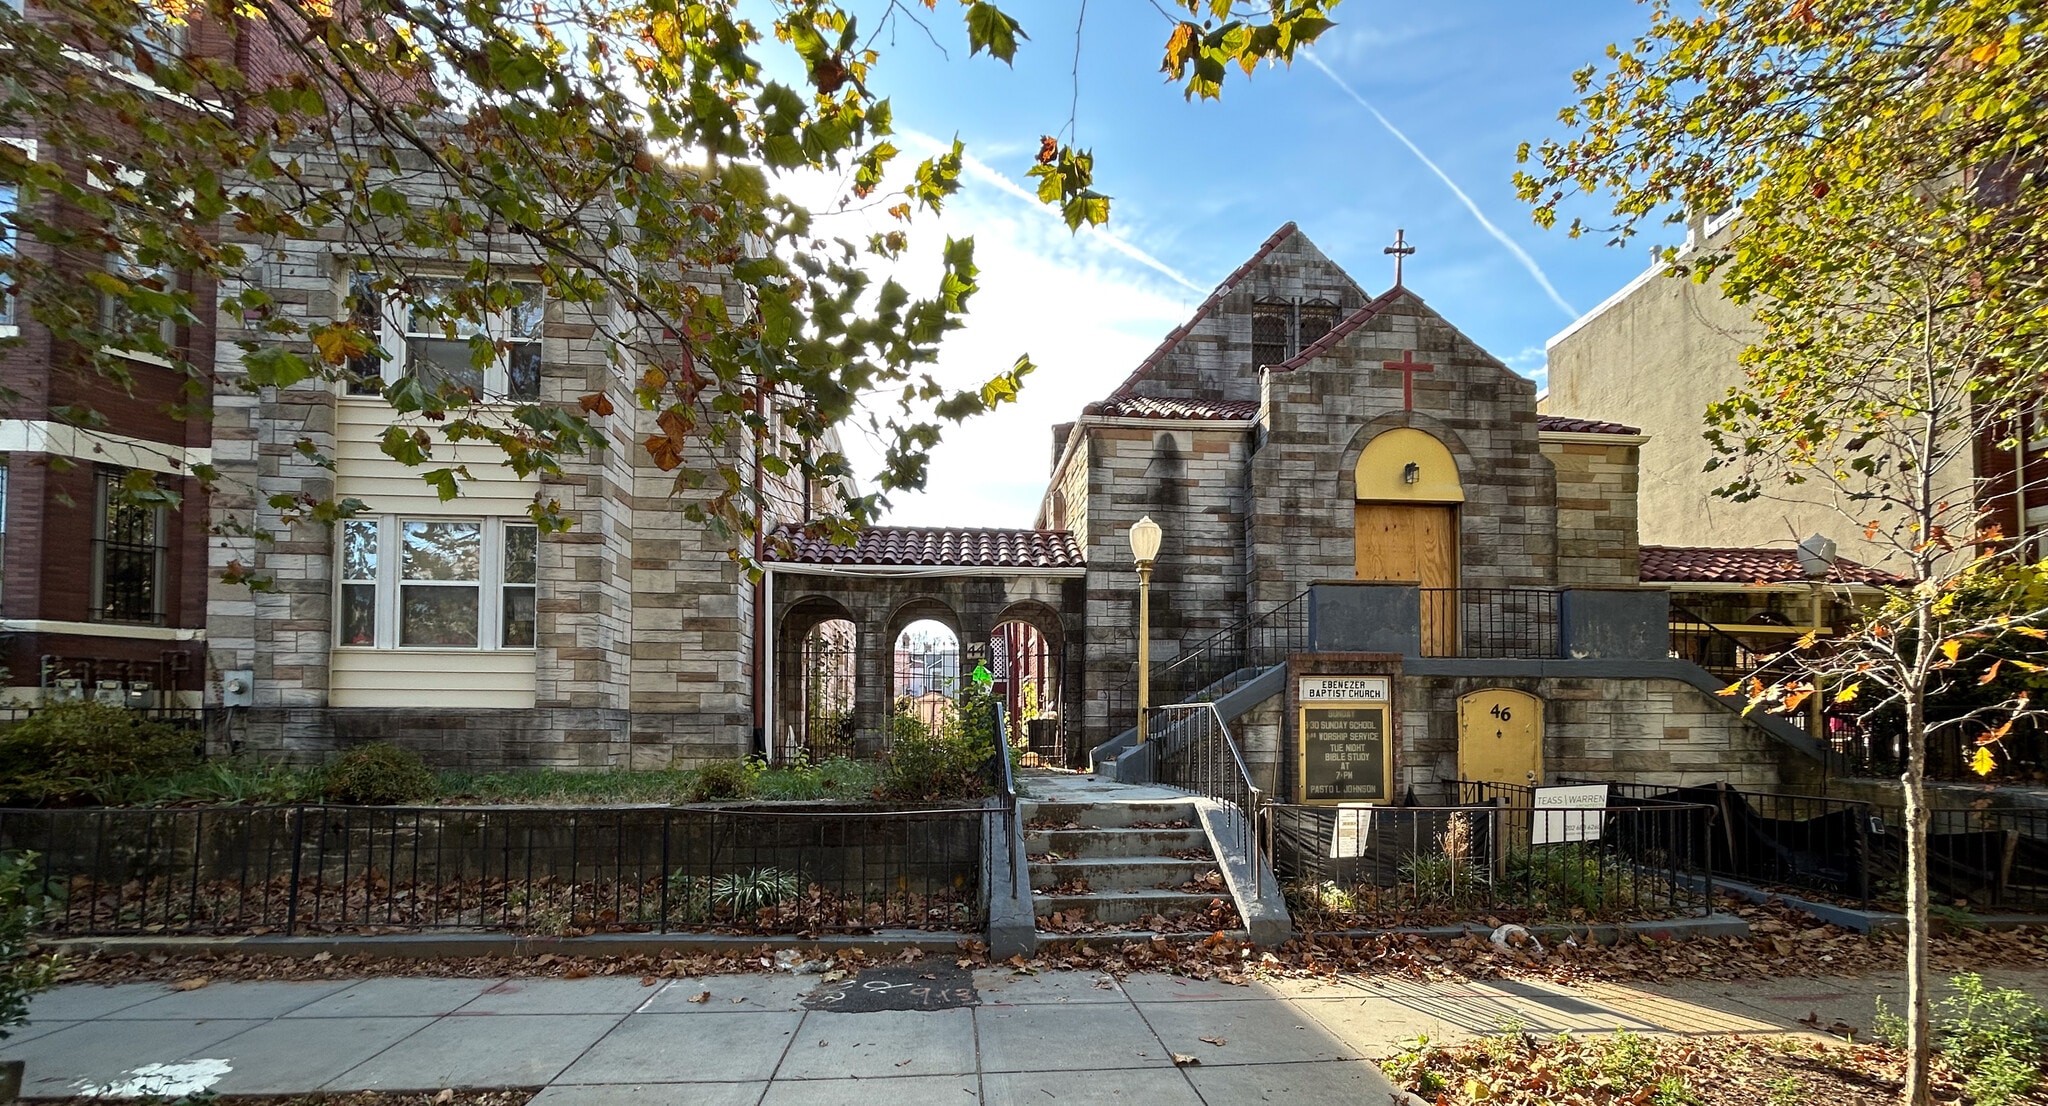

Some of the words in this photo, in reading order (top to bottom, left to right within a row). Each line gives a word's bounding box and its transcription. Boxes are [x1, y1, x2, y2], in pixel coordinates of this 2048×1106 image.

[967, 644, 984, 656] 44
[1322, 681, 1365, 689] EBENEZER
[1309, 689, 1346, 698] BAPTIST
[1348, 689, 1380, 698] CHURCH
[1328, 710, 1355, 718] SUNDAY
[1490, 703, 1511, 721] 46
[1320, 721, 1347, 729] SUNDAY
[1348, 721, 1376, 729] SCHOOL
[1318, 732, 1347, 741] WORSHIP
[1349, 732, 1379, 741] SERVICE
[1330, 743, 1343, 752] TUE
[1345, 743, 1365, 752] NIGHT
[1325, 753, 1345, 761] BIBLE
[1347, 753, 1370, 761] STUDY
[1340, 762, 1350, 770] AT
[1310, 785, 1334, 794] PASTO
[1335, 785, 1341, 794] L
[1343, 785, 1376, 793] JOHNSON
[1538, 796, 1563, 805] TEASS
[1569, 795, 1605, 804] WARREN
